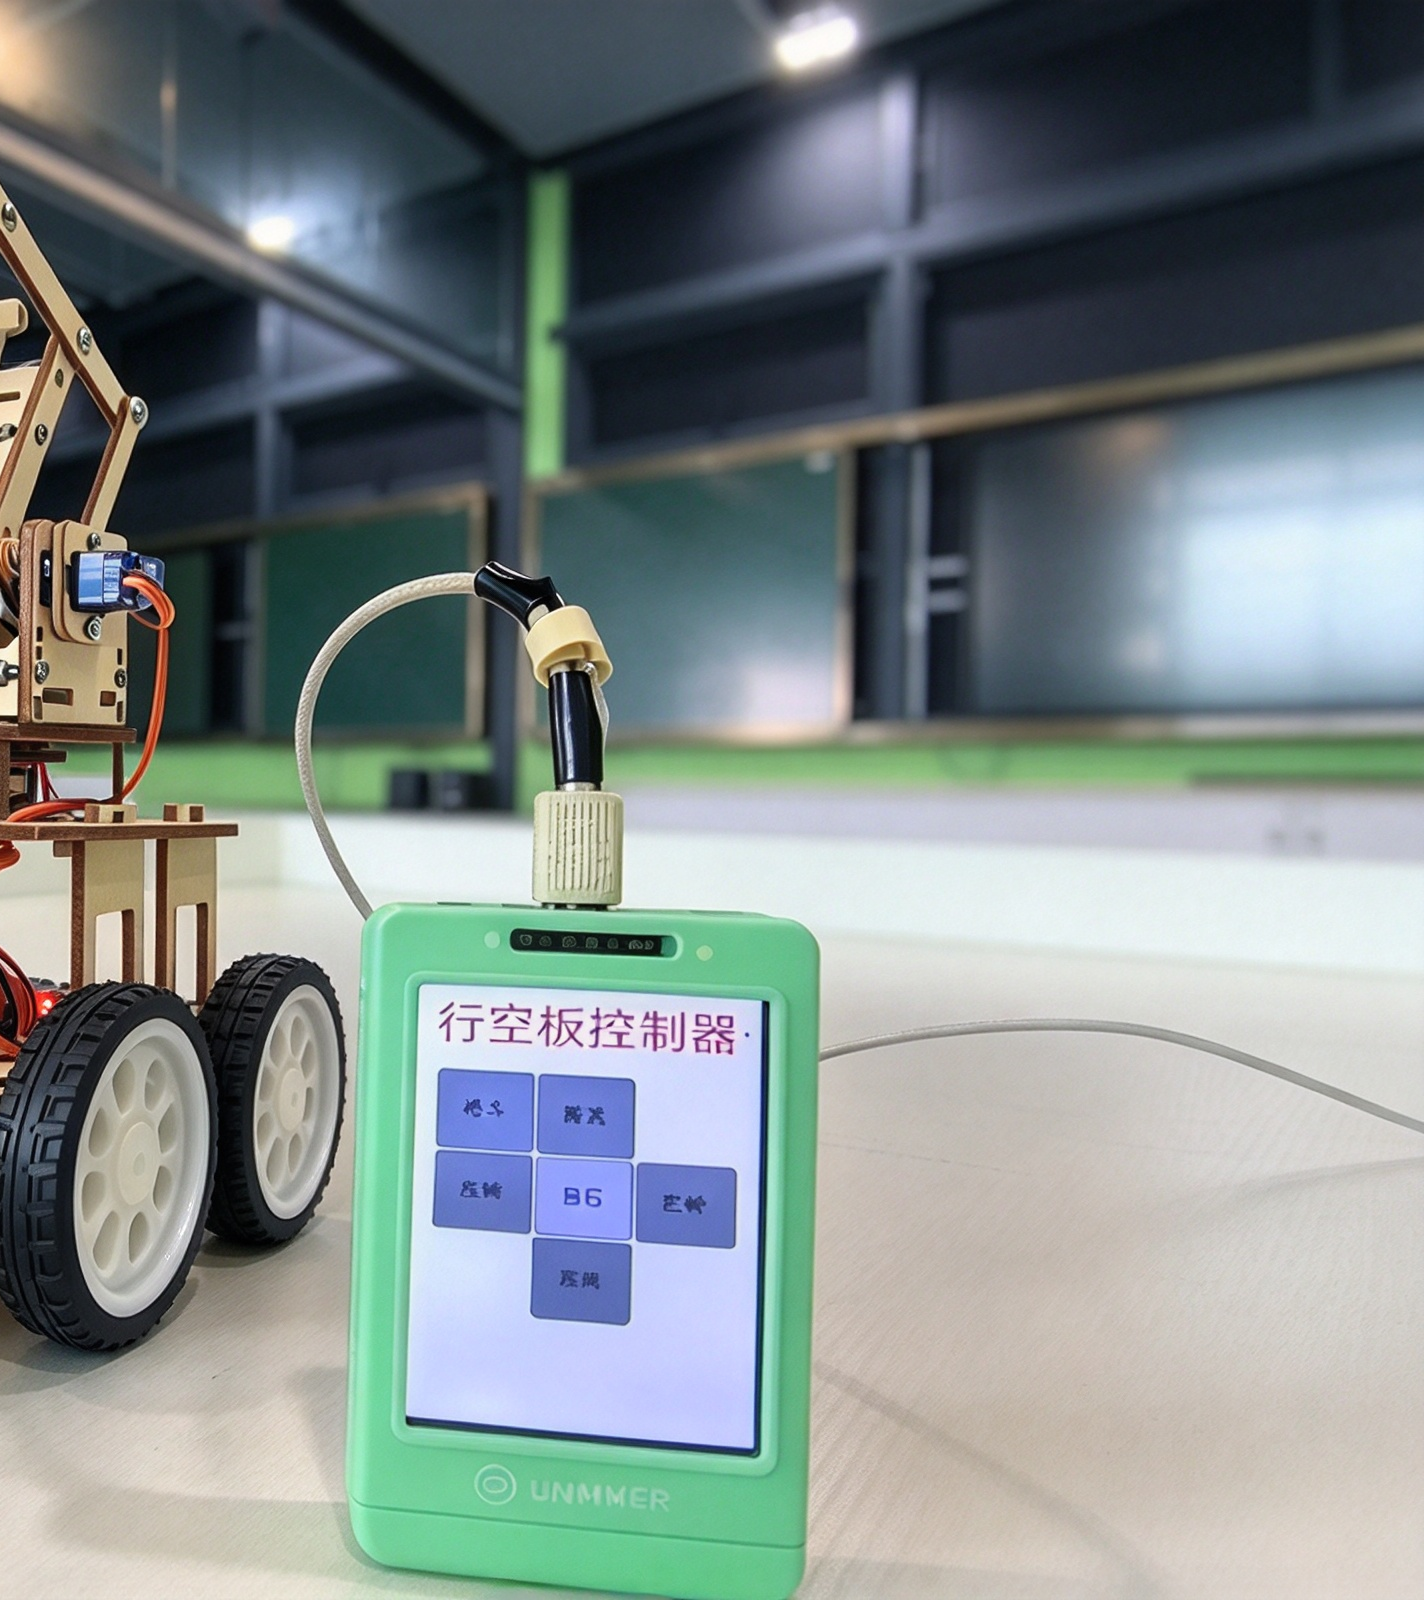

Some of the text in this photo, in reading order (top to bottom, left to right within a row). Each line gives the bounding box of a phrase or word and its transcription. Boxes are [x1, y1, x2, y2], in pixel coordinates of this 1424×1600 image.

[438, 1001, 736, 1055] 行空板控制器
